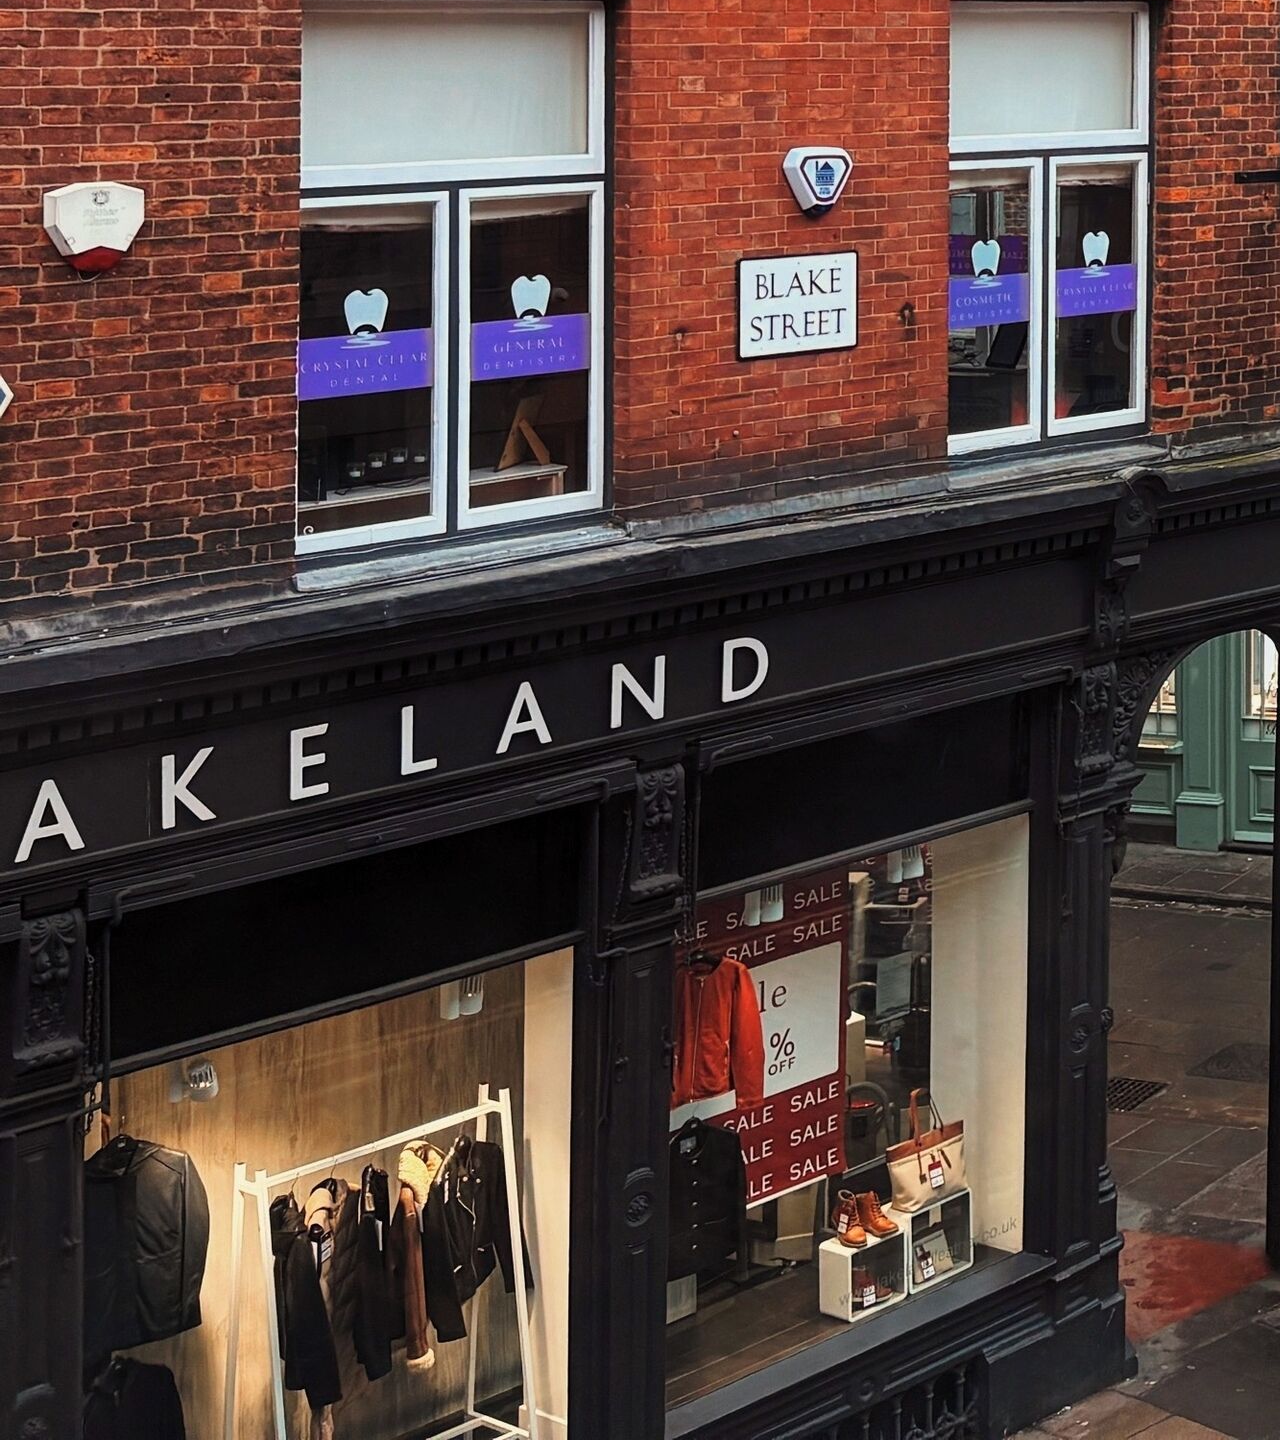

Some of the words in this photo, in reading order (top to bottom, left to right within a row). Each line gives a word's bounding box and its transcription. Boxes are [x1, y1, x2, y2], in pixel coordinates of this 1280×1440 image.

[755, 267, 842, 300] BLAKE
[955, 292, 1012, 308] COSMETIC
[750, 307, 847, 342] STREET
[493, 336, 563, 353] GENERAL
[300, 357, 368, 374] CRYSTAL
[378, 351, 427, 366] CLEAR
[483, 354, 576, 371] DENTISTRY
[330, 373, 398, 388] DENTAL
[794, 880, 843, 910] SALE
[793, 914, 843, 944] SALE
[768, 1056, 796, 1076] OFF
[790, 1080, 839, 1113] SALE
[790, 1113, 838, 1147] SALE
[790, 1147, 839, 1181] SALE
